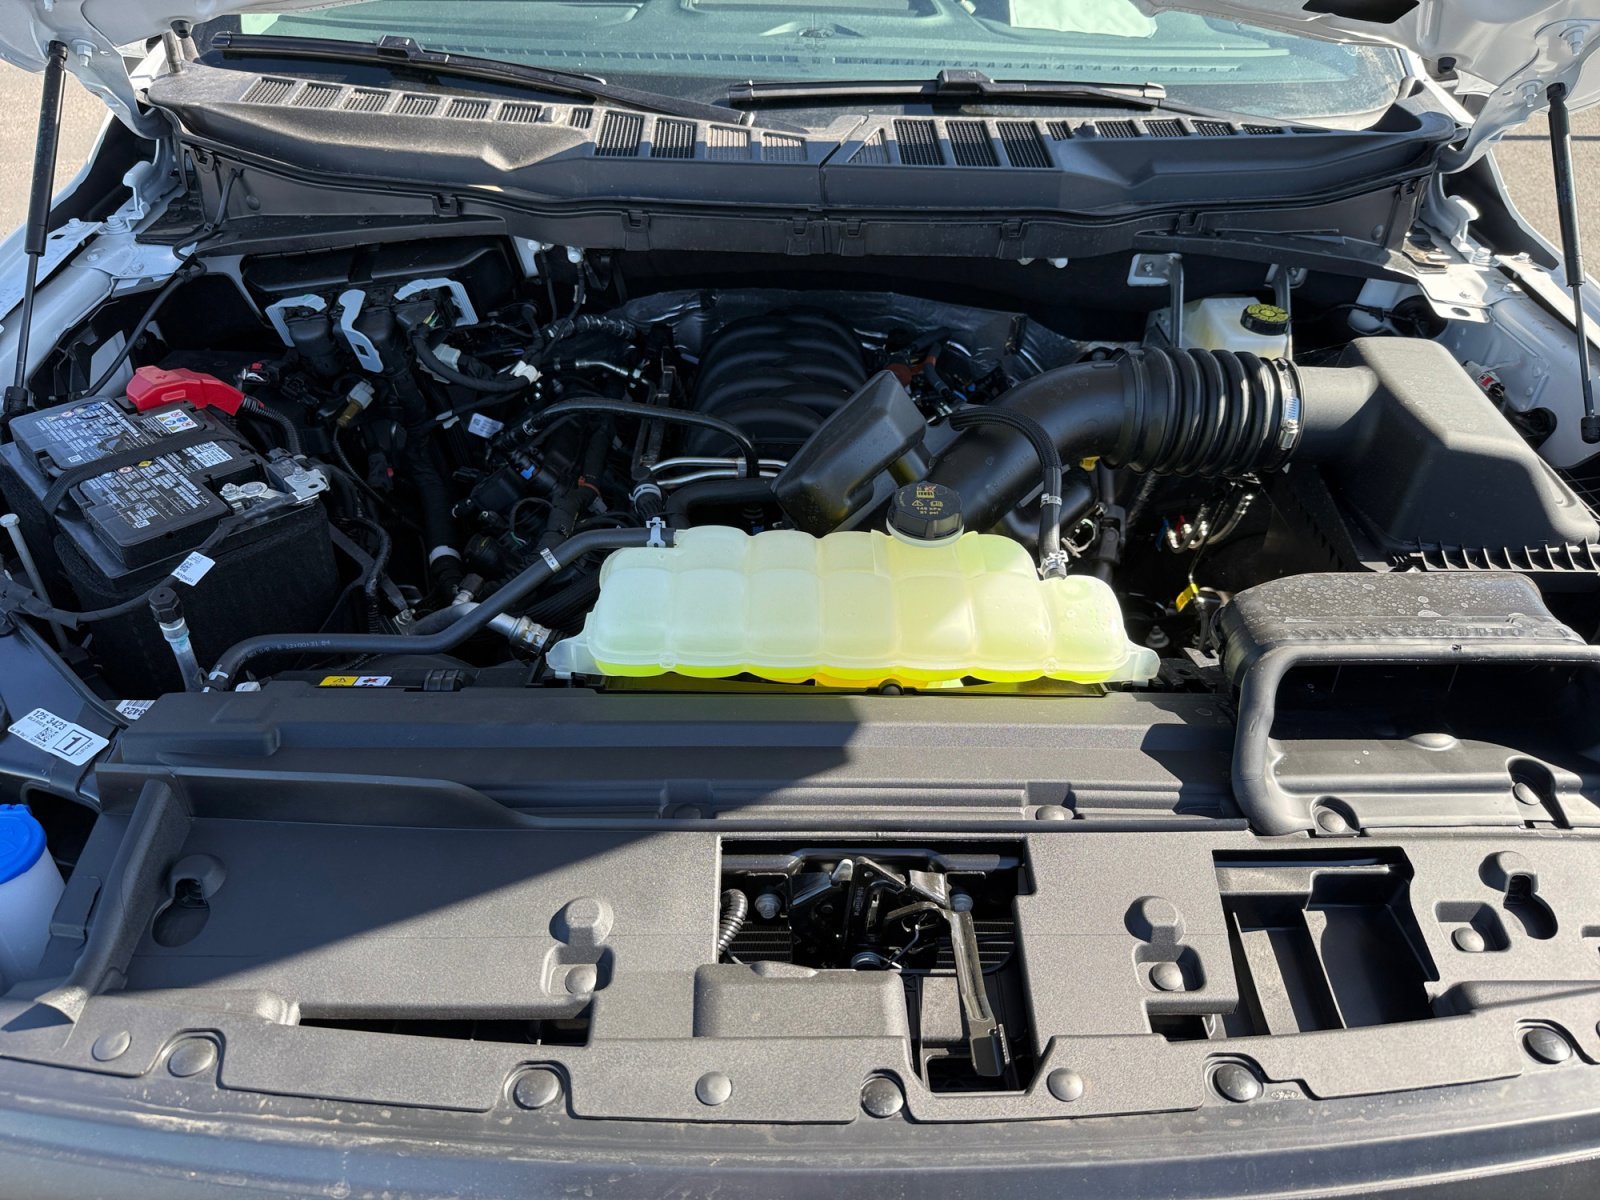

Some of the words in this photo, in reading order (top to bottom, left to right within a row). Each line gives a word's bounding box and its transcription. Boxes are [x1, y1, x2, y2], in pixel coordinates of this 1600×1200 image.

[32, 710, 49, 720] 125
[46, 717, 67, 731] 3423
[63, 736, 82, 751] 1
